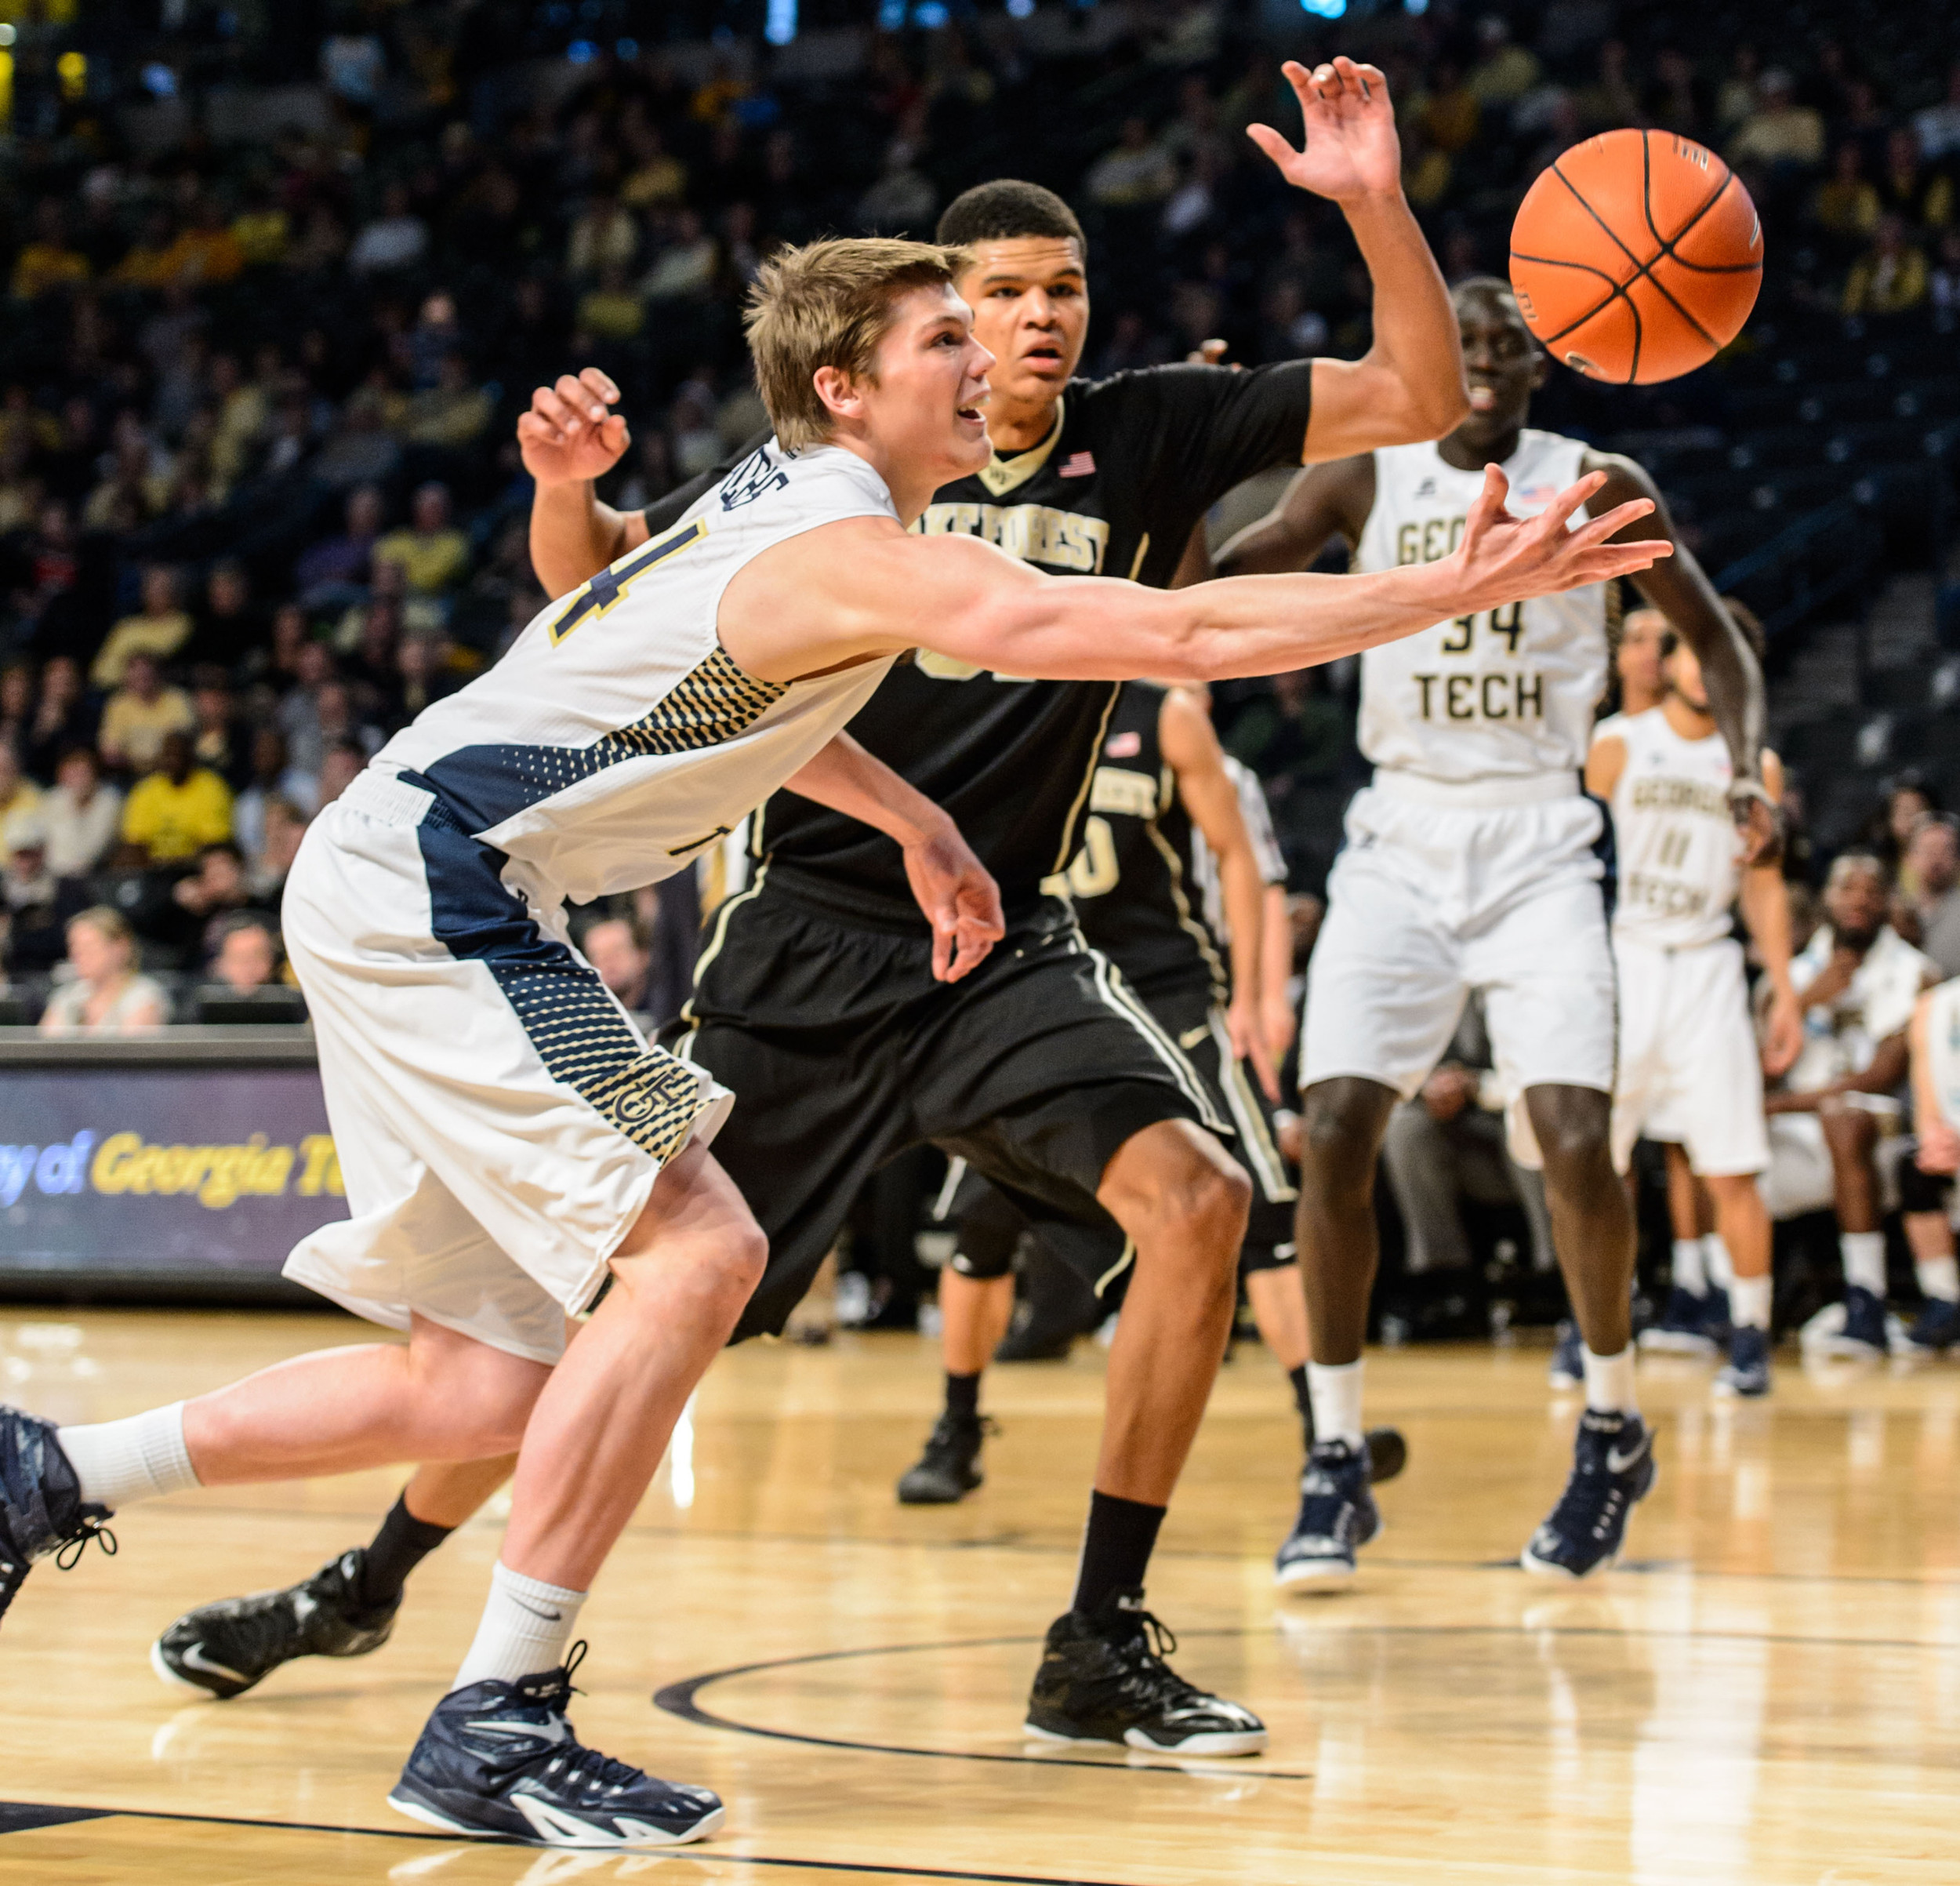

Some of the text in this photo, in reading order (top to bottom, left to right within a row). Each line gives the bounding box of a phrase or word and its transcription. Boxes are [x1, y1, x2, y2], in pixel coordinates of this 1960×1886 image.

[1440, 600, 1526, 656] 34
[1413, 671, 1544, 722] TECH
[1658, 827, 1693, 870] 11
[91, 1130, 296, 1208] Georgia
